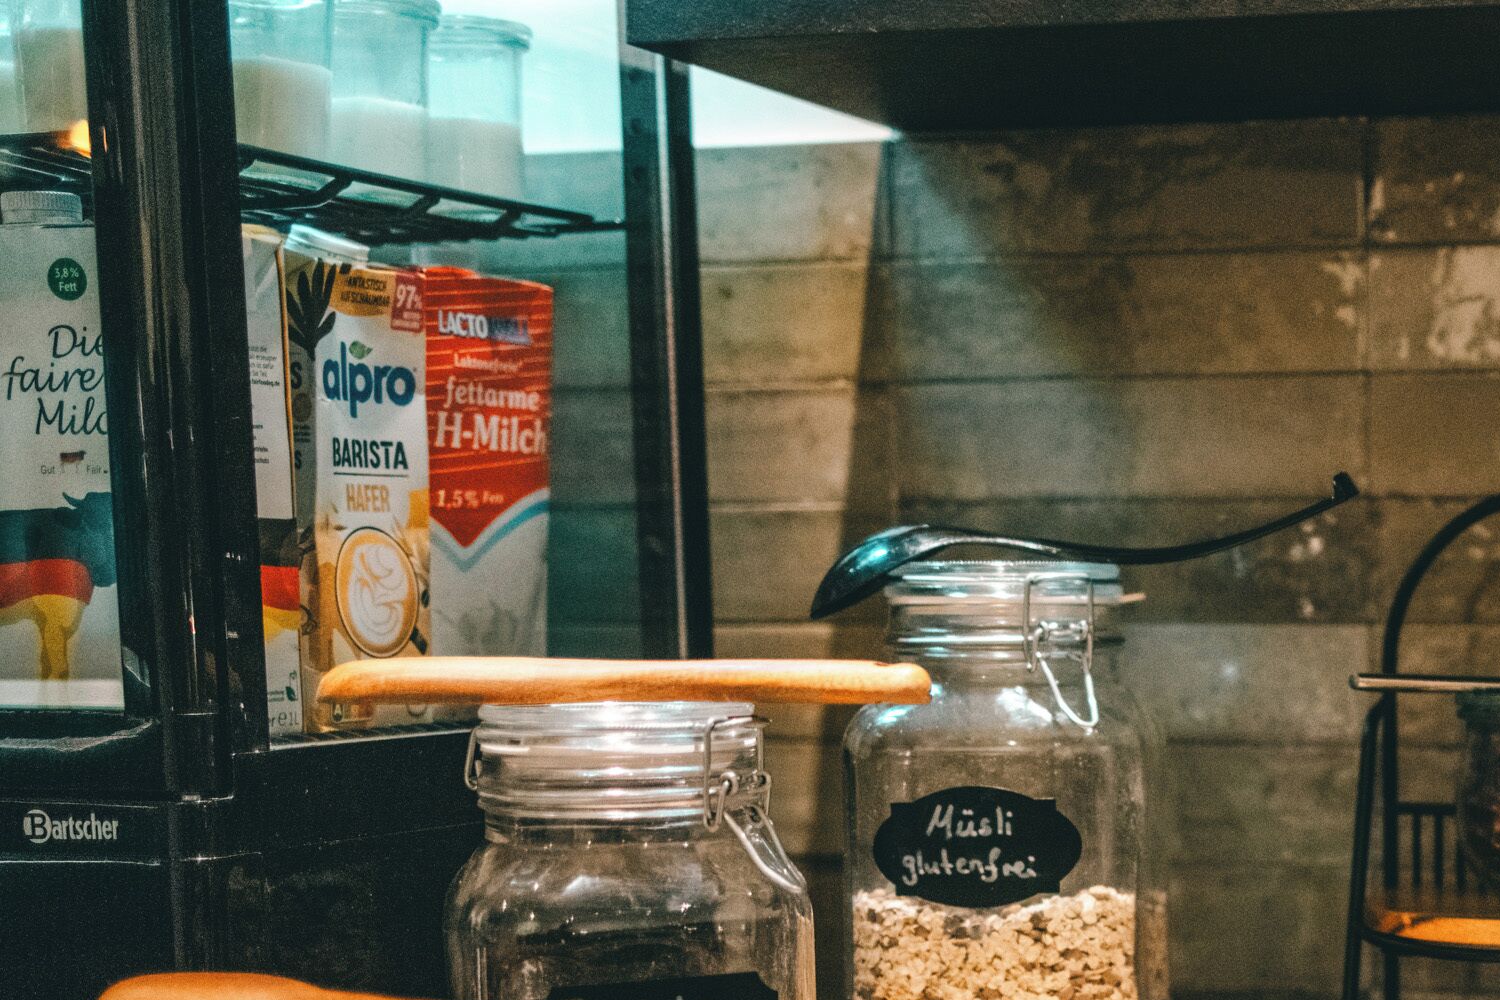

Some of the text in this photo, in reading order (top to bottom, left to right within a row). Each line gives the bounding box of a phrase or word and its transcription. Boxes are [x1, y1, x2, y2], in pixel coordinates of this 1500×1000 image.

[58, 281, 77, 292] Fett
[2, 356, 104, 401] faire
[322, 341, 416, 419] alpro
[443, 375, 541, 412] fettarme
[36, 396, 109, 435] Milc
[433, 410, 547, 456] H-Milch
[332, 436, 409, 470] BARISTA
[345, 483, 391, 513] HAFER
[22, 808, 119, 844] Bartscher
[925, 803, 1014, 839] Müsli
[901, 846, 1038, 887] glutenfrei
